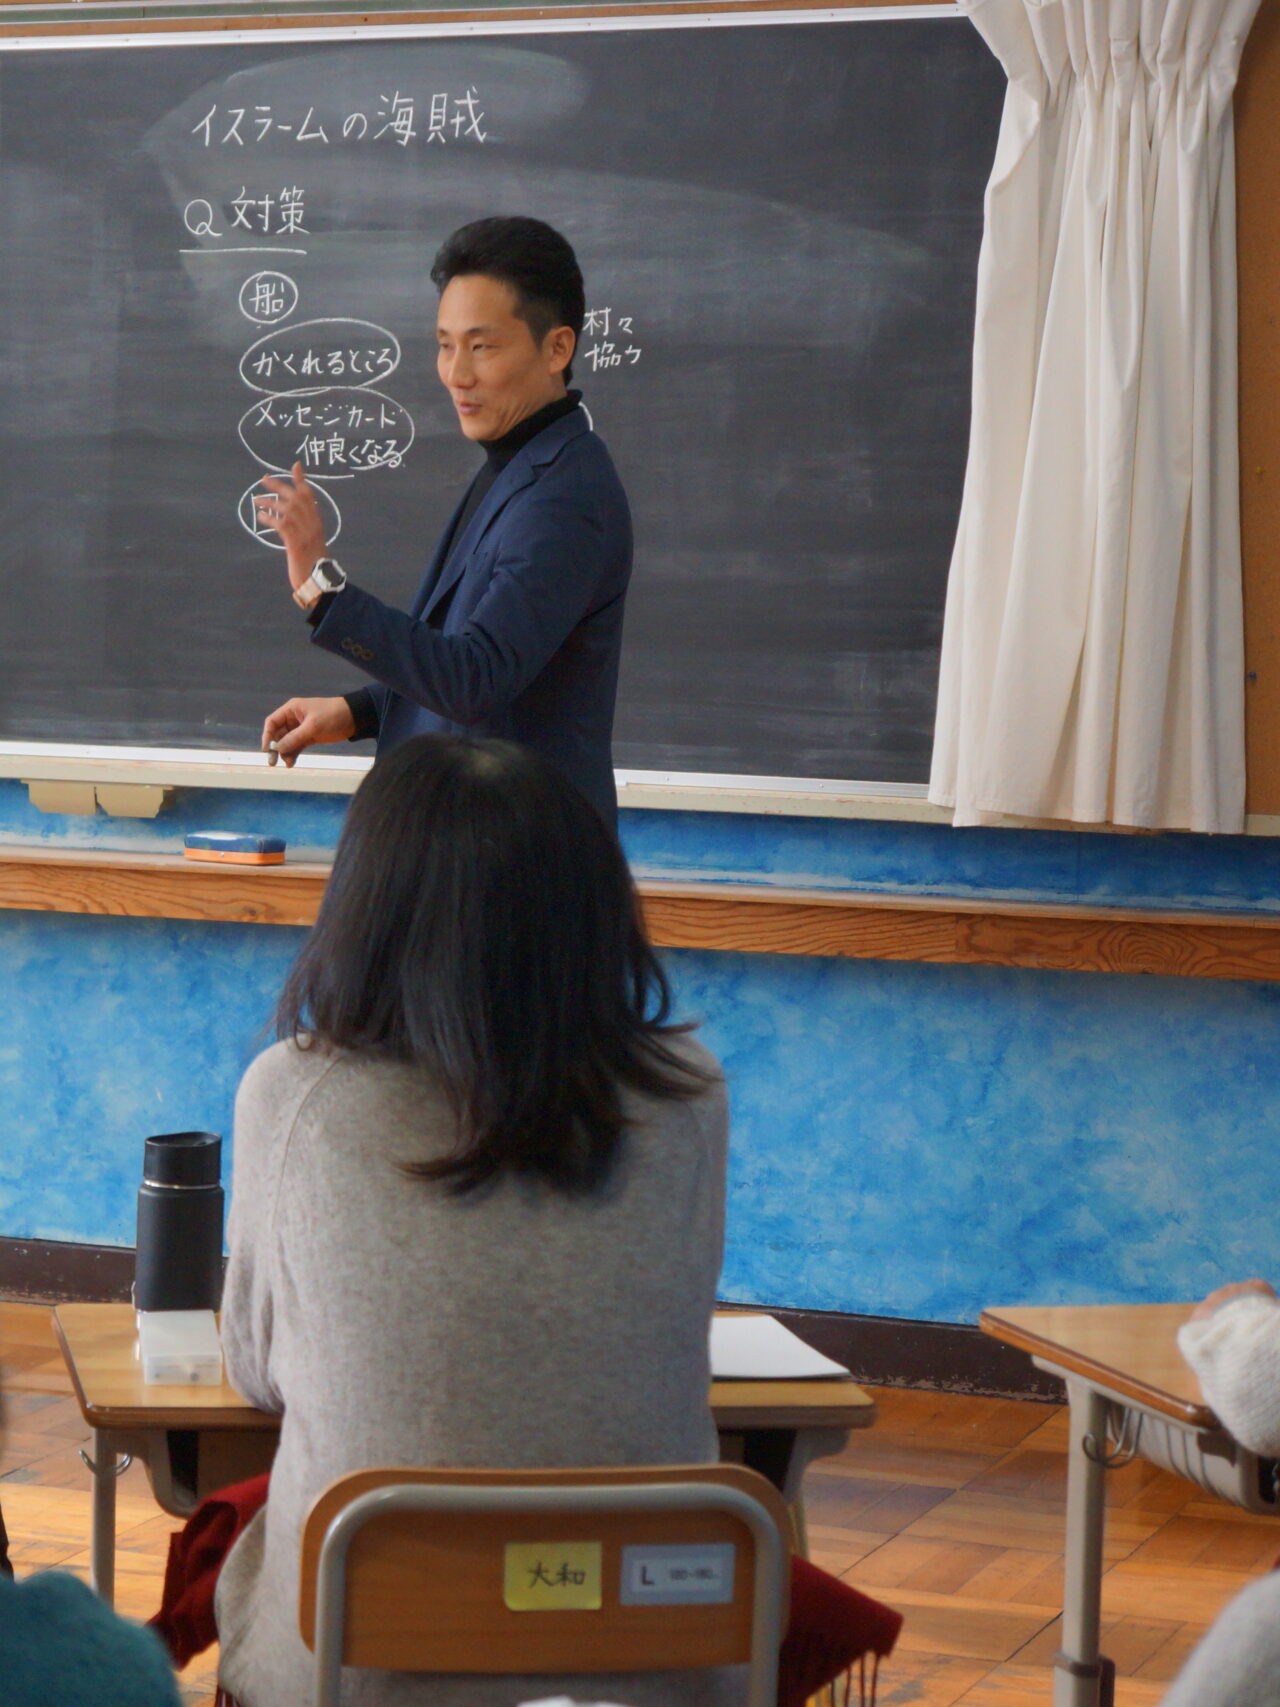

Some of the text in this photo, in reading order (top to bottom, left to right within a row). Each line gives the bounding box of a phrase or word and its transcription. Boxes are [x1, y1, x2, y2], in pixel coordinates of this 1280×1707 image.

[191, 86, 488, 147] イスラームの海賊
[183, 185, 311, 237] Q 対策
[249, 279, 284, 316] 船
[582, 306, 634, 337] 村々
[252, 350, 397, 376] かくれるところ
[584, 341, 642, 373] 協力
[255, 401, 404, 429] メッセージカード
[295, 432, 403, 468] 仲良くなる
[527, 1560, 587, 1590] 大和
[640, 1566, 655, 1585] L
